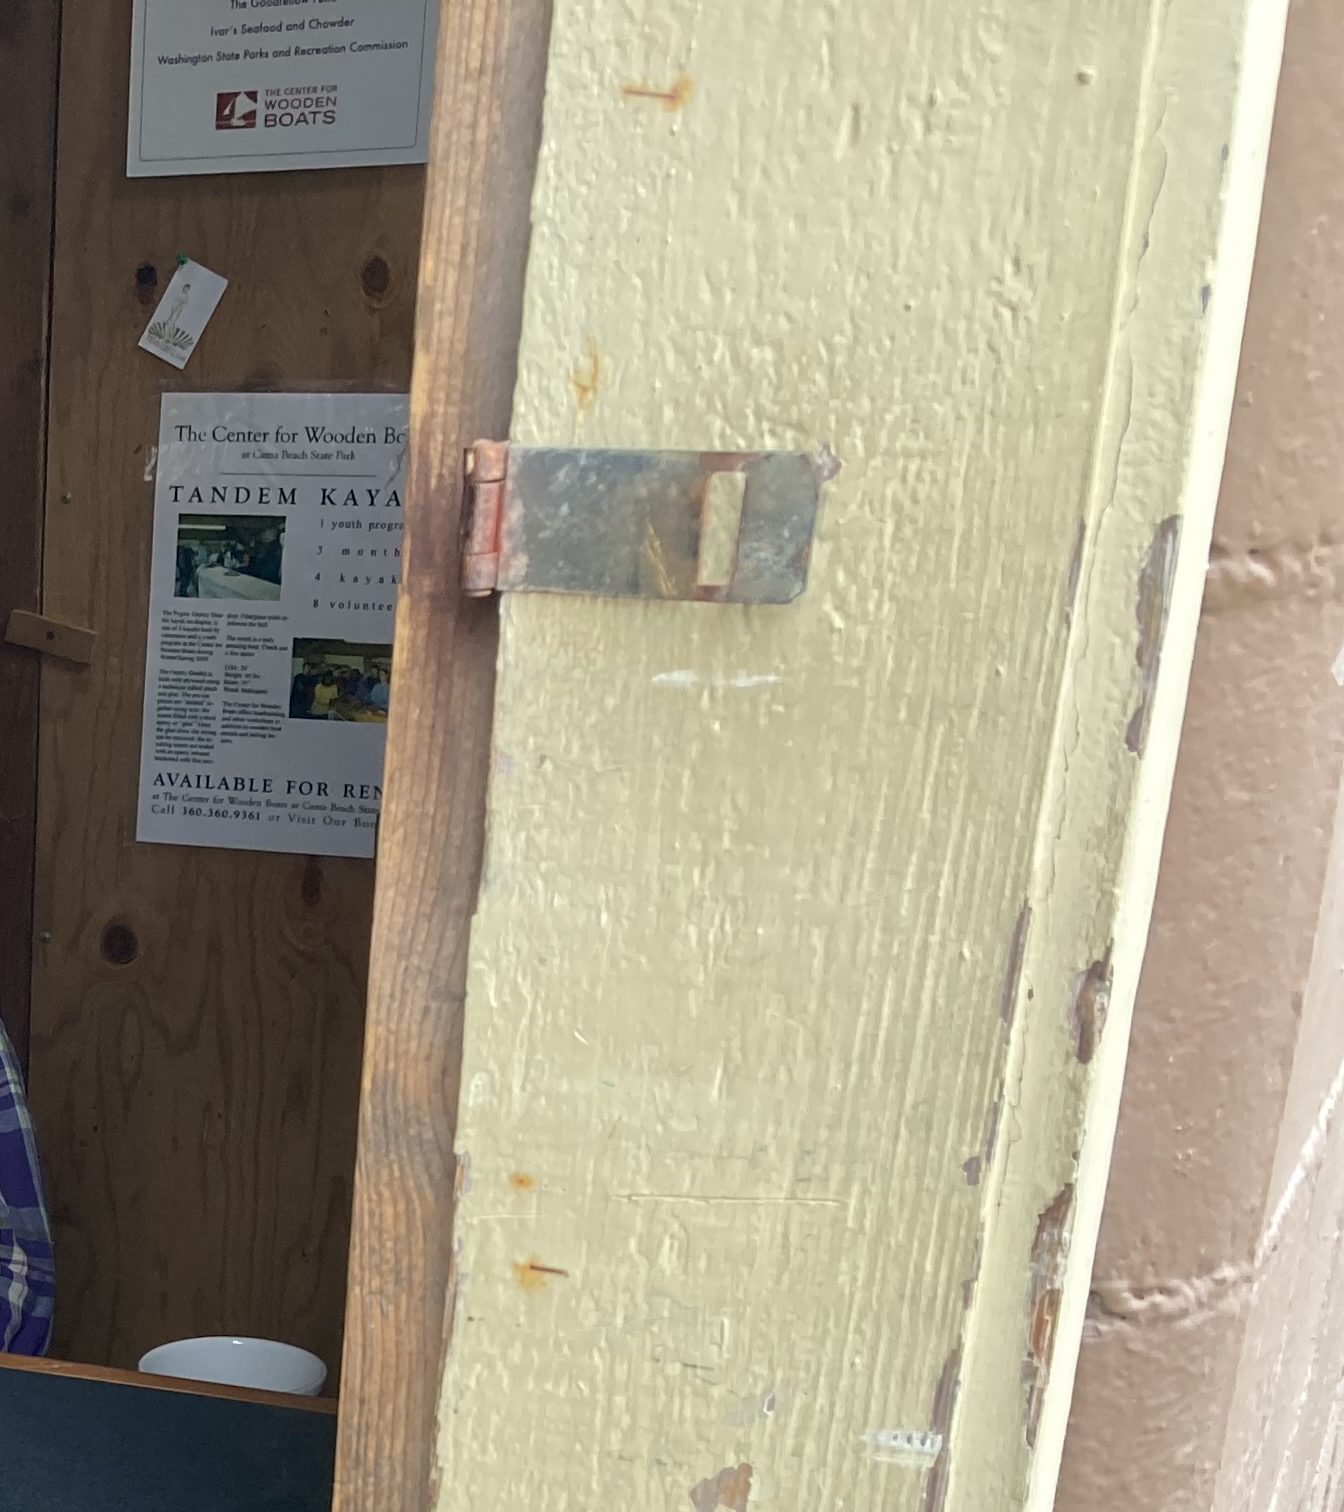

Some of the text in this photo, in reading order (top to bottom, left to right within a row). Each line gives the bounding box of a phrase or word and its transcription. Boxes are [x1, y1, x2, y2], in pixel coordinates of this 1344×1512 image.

[210, 17, 355, 36] Ivar's Seafood and Chowder
[157, 39, 408, 66] Washington State Parks and Recreation Commission
[265, 84, 338, 96] THE CENTER FOR
[264, 96, 337, 110] WOODEN
[264, 110, 336, 127] BOATS
[174, 424, 206, 442] The
[212, 425, 269, 443] Center
[275, 426, 298, 443] for
[304, 426, 376, 444] Wooden
[281, 450, 307, 460] Beach
[310, 450, 333, 460] State
[336, 451, 355, 460] Park
[169, 485, 297, 505] TANDEM
[331, 519, 362, 531] youth
[153, 772, 273, 793] AVAILABLE
[286, 780, 329, 797] FOR
[163, 791, 178, 801] The
[182, 793, 209, 803] Center
[213, 795, 224, 804] for
[228, 796, 261, 807] Wooden
[330, 802, 355, 813] Beach
[151, 804, 175, 815] Call
[288, 813, 315, 825] Visit
[323, 815, 346, 827] Our
